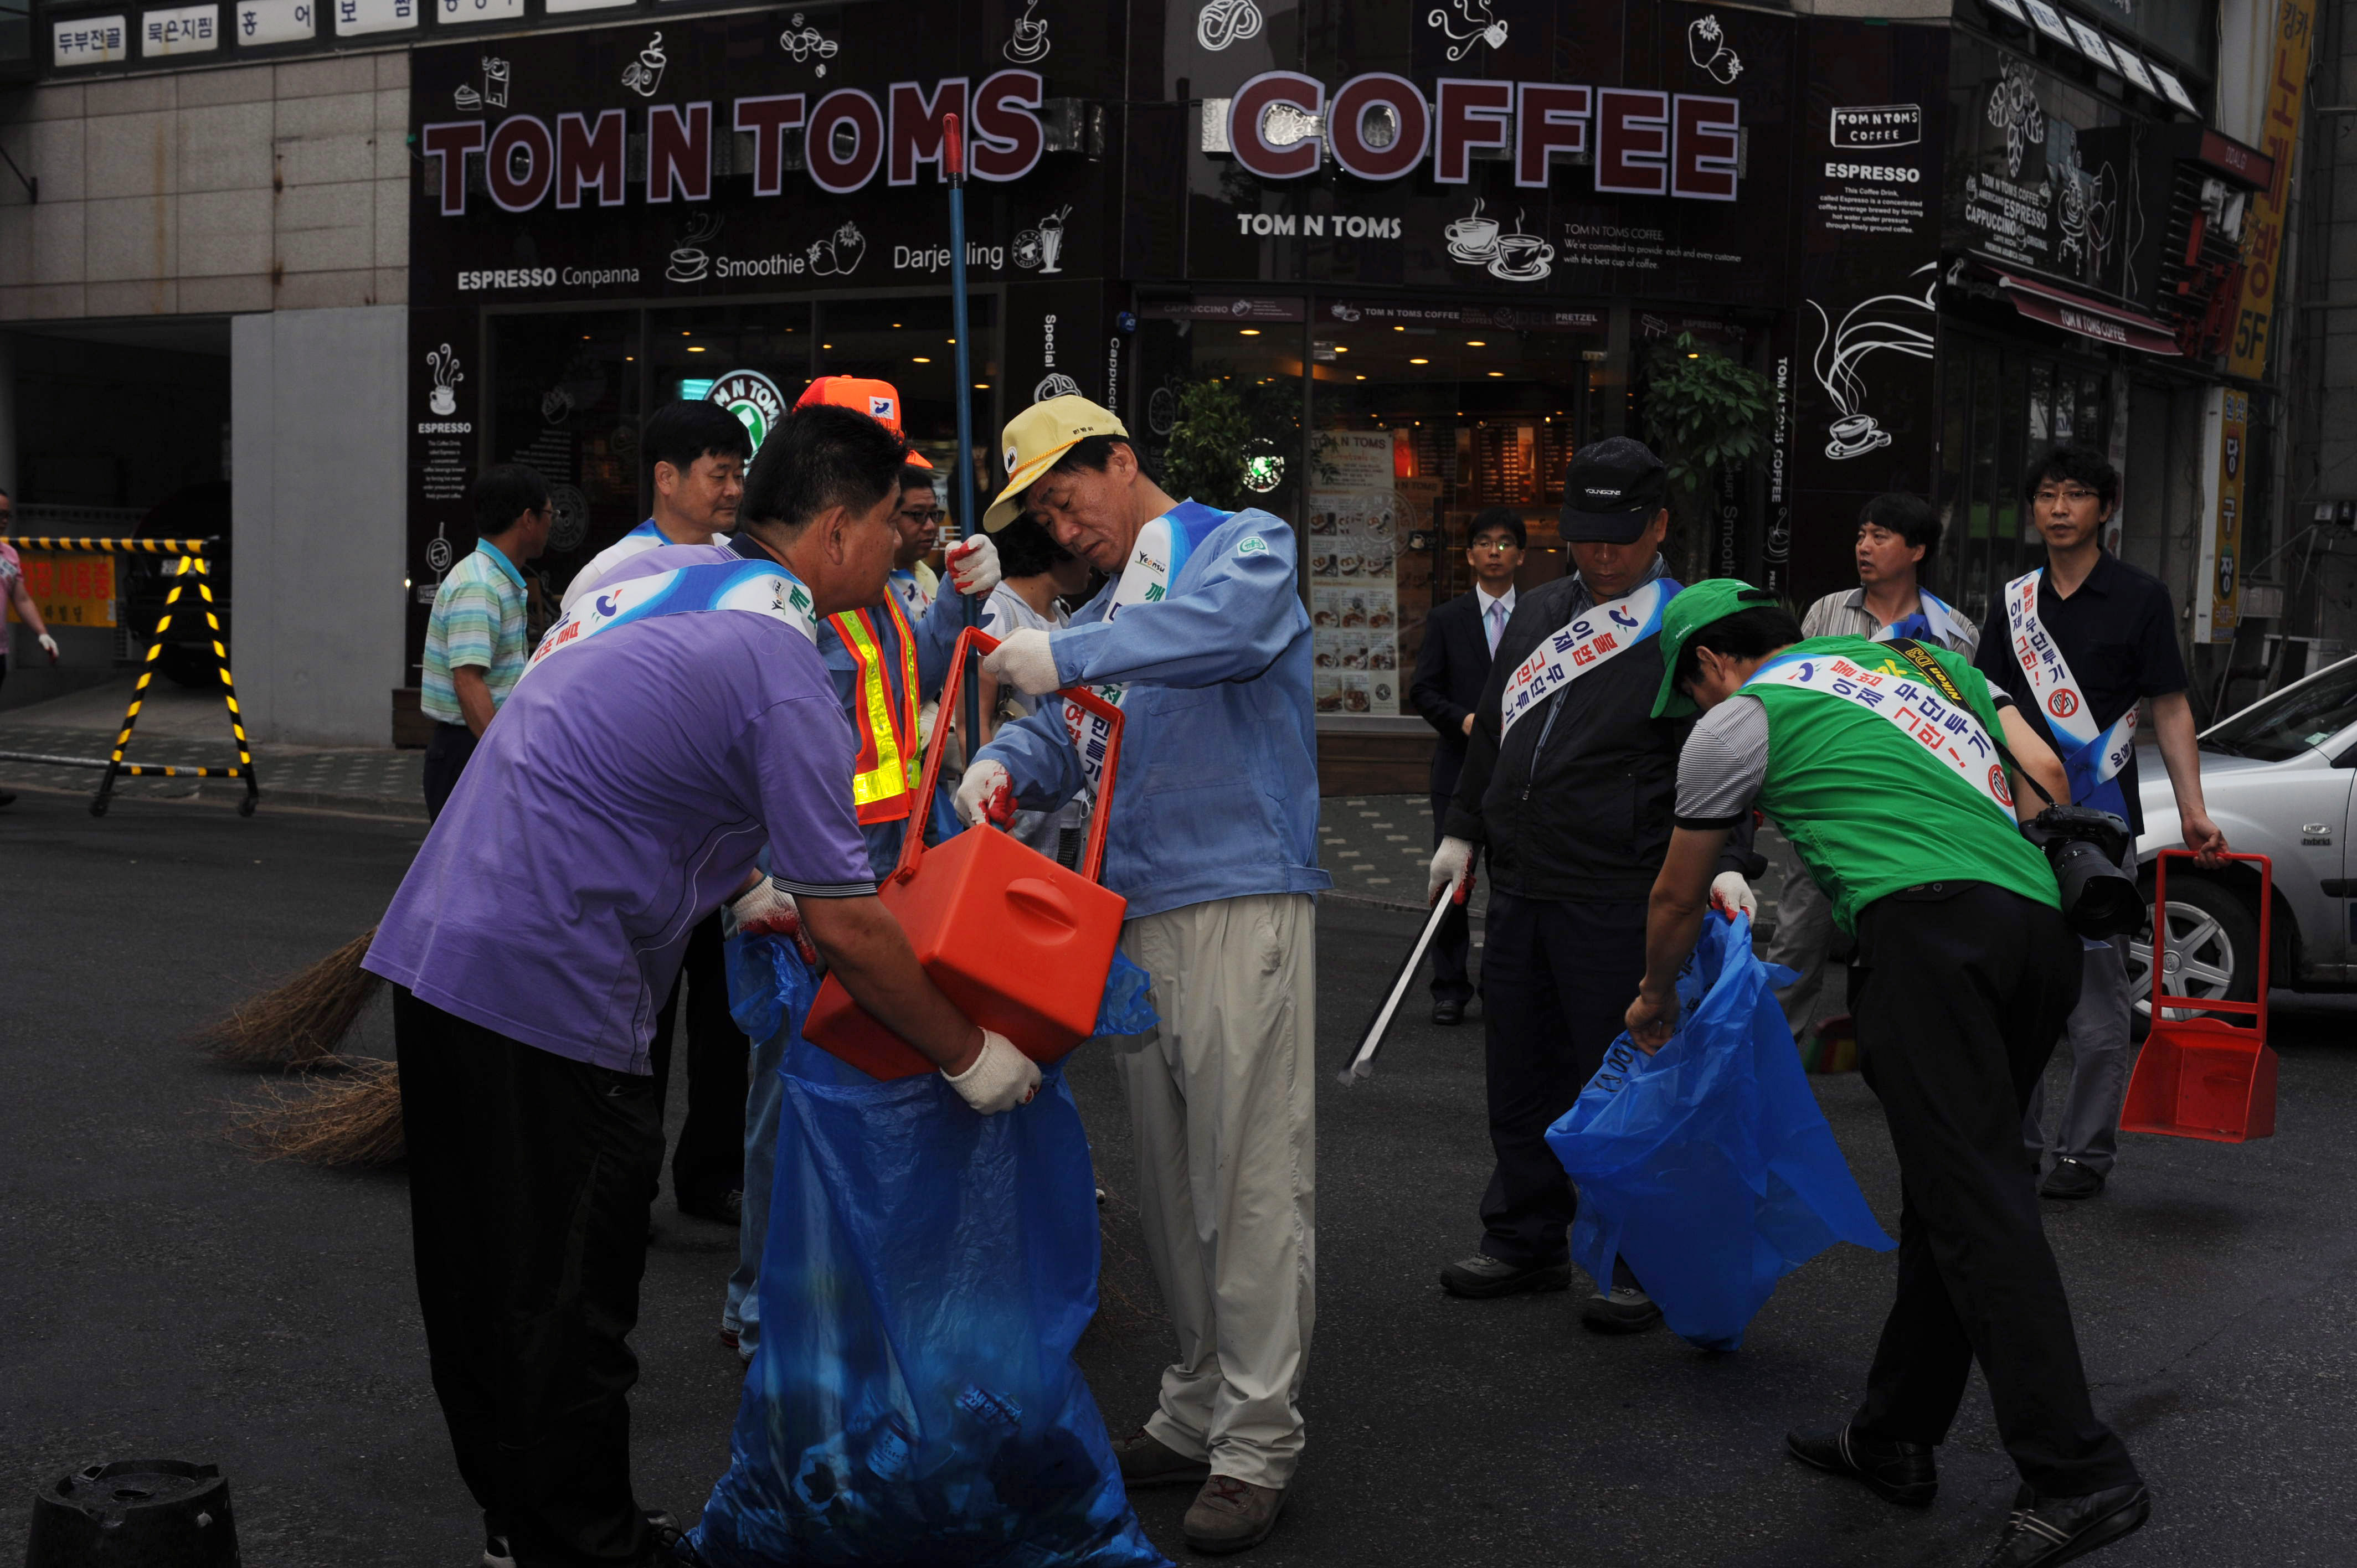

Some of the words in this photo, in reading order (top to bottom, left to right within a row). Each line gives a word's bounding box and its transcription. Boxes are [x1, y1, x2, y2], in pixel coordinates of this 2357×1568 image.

[58, 28, 121, 54] 두부전골
[148, 17, 213, 43] 묵은지찜
[1838, 114, 1869, 126] TOM
[1872, 114, 1882, 125] N
[1884, 112, 1918, 123] TOMS
[423, 109, 626, 216] TOM
[646, 101, 713, 203] N
[733, 69, 1044, 197] TOMS
[1227, 70, 1740, 202] COFFEE
[1850, 130, 1900, 142] COFFEE
[1825, 163, 1920, 183] ESPRESSO
[1982, 173, 1994, 189] TOM
[1995, 178, 2000, 191] N
[2018, 188, 2039, 206] COFFEE
[1839, 205, 1867, 214] beverage
[1901, 209, 1923, 217] forcing
[1965, 204, 2016, 236] CAPPUCCINO
[2004, 198, 2047, 230] ESPRESSO
[1237, 214, 1295, 236] TOM
[1304, 215, 1323, 236] N
[1331, 215, 1401, 239] TOMS
[1565, 223, 1589, 235] TOM
[1591, 225, 1602, 236] N
[1602, 226, 1629, 238] TOMS
[1826, 221, 1850, 230] through
[1852, 223, 1869, 231] finely
[894, 244, 1003, 273] Darjeling
[1564, 238, 1587, 249] We're
[1589, 241, 1626, 253] committed
[1628, 245, 1635, 253] to
[1666, 249, 1681, 257] each
[1594, 255, 1610, 266] best
[1612, 259, 1624, 268] cup
[1627, 257, 1635, 267] of
[457, 267, 557, 290] ESPRESSO
[562, 266, 639, 288] Conpanna
[716, 253, 805, 278] Smoothie
[1164, 305, 1228, 314] CAPPUCCINO
[1364, 308, 1385, 317] TOM
[1397, 309, 1422, 318] TOMS
[1424, 310, 1460, 319] COFFEE
[1556, 313, 1598, 322] PRETZEL
[1044, 314, 1056, 367] Special
[2235, 309, 2267, 360] 5F
[1777, 357, 1788, 388] TOM
[418, 422, 471, 434] ESPRESSO
[1355, 437, 1386, 449] TOMS
[1771, 449, 1784, 503] COFFEE
[2221, 438, 2238, 592] 당구장
[1720, 506, 1738, 576] Smooth
[1139, 550, 1165, 574] Yeonsu
[2023, 582, 2035, 613] 불법
[2010, 599, 2022, 632] 이제
[1552, 621, 1594, 653] 이제
[1572, 632, 1618, 666] 불법
[2025, 617, 2065, 683] 무단투기
[1905, 647, 1934, 668] D3
[1506, 663, 1565, 724] 무단투기
[1832, 678, 1885, 708] 이제
[1929, 667, 1962, 700] Nikon
[1830, 661, 1884, 687] 불법
[1894, 682, 1991, 759] 무단투기
[1085, 715, 1112, 782] 만들기
